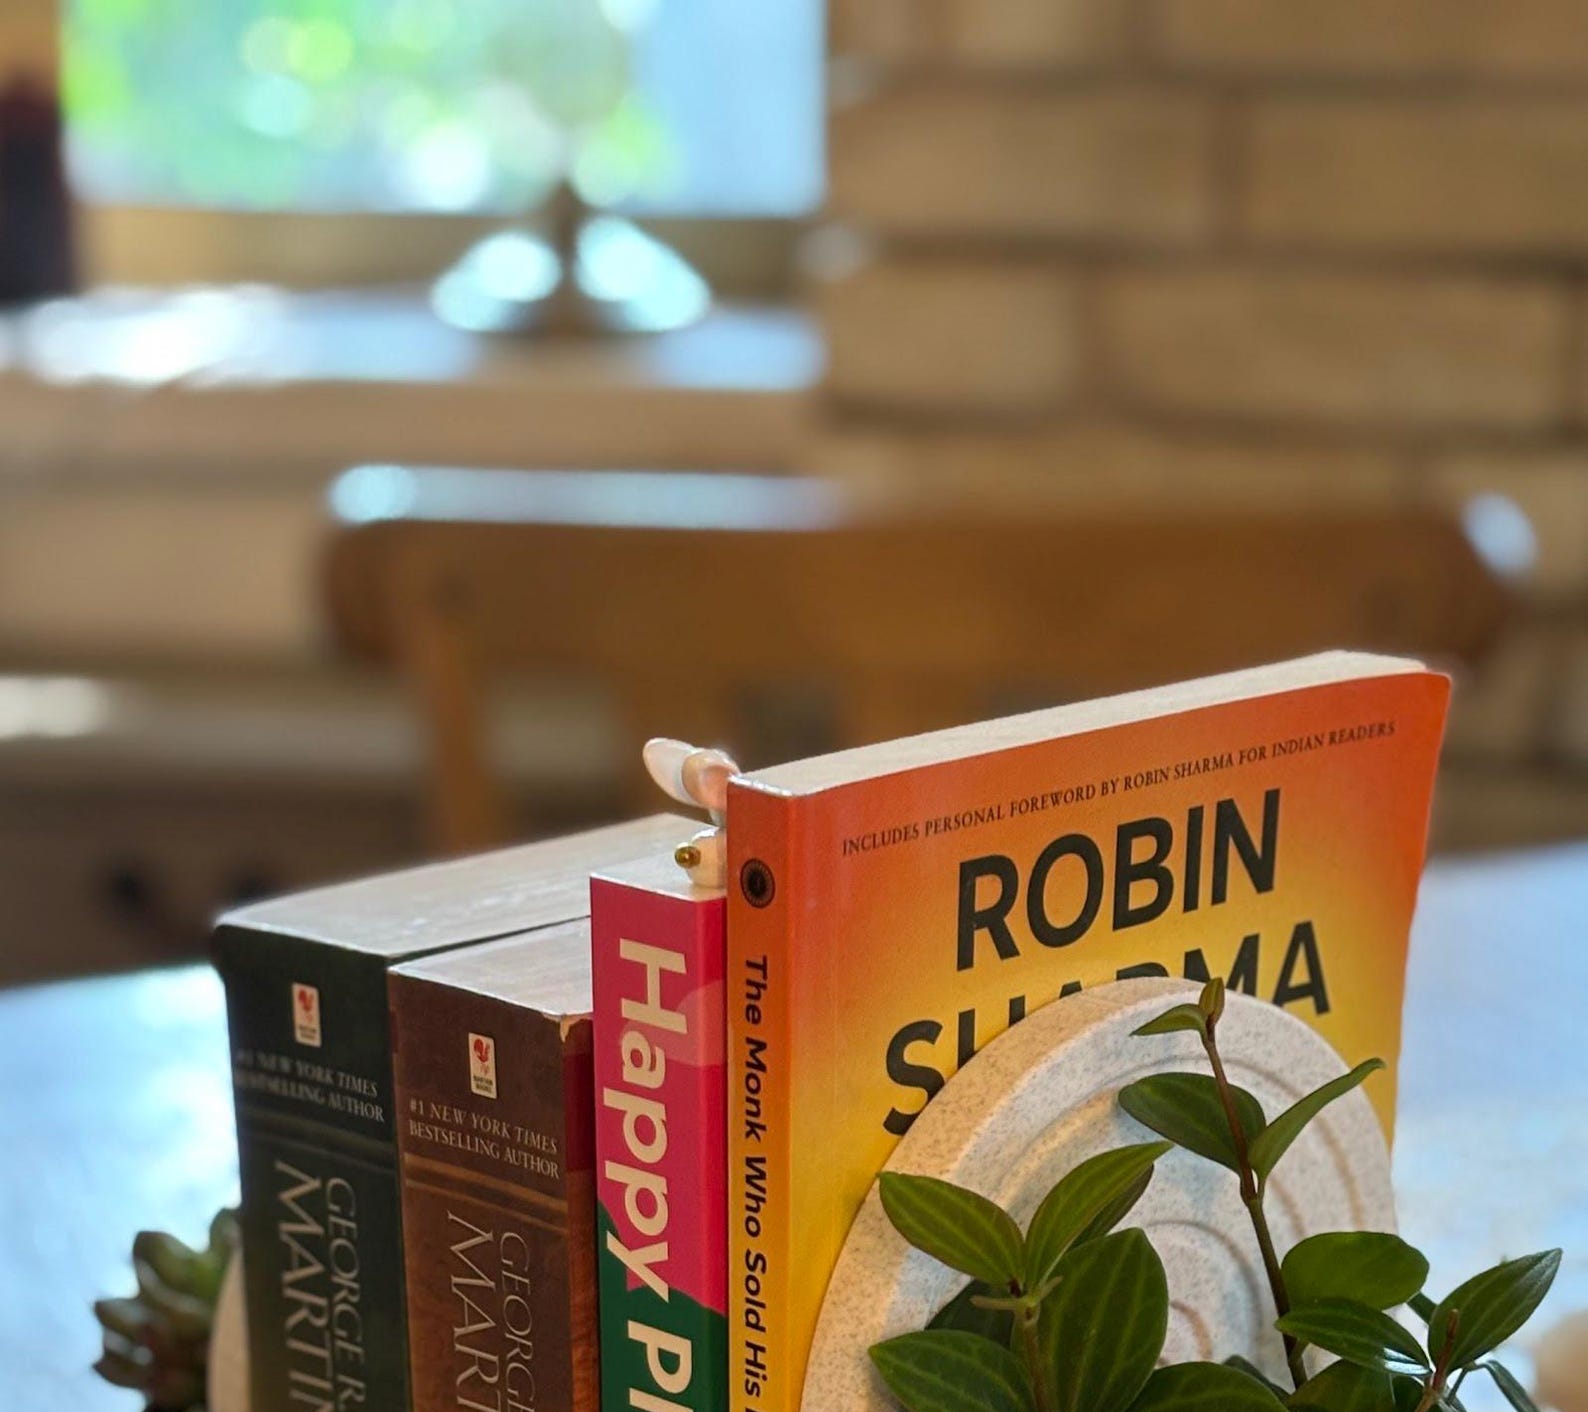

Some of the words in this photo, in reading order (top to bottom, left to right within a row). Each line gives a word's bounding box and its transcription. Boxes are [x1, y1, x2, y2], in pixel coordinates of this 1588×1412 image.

[841, 824, 919, 856] INCLUDES
[924, 805, 1004, 838] PERSONAL
[1009, 784, 1096, 818] FOREWORD
[1100, 778, 1120, 796] BY
[1123, 767, 1169, 791] ROBIN
[1173, 754, 1234, 781] SHARMA
[1239, 746, 1267, 765] FOR
[1271, 733, 1325, 758] INDIAN
[1328, 720, 1396, 745] READERS
[956, 789, 1281, 972] ROBIN
[745, 955, 768, 1025] The
[882, 921, 1332, 1137] SMA
[296, 1061, 335, 1086] YORK
[335, 1072, 379, 1098] TIMES
[327, 1093, 385, 1123] AUTHOR
[602, 938, 689, 1303] Happy
[744, 1036, 768, 1143] Monk
[409, 1098, 425, 1116] #1
[430, 1103, 467, 1125] NEW
[471, 1112, 511, 1139] YORK
[515, 1126, 558, 1154] TIMES
[409, 1119, 500, 1160] BESTSELLING
[504, 1147, 560, 1180] AUTHOR
[744, 1156, 767, 1239] Who
[325, 1176, 365, 1367] GEORGE
[744, 1248, 767, 1333] Sold
[744, 1342, 767, 1400] His
